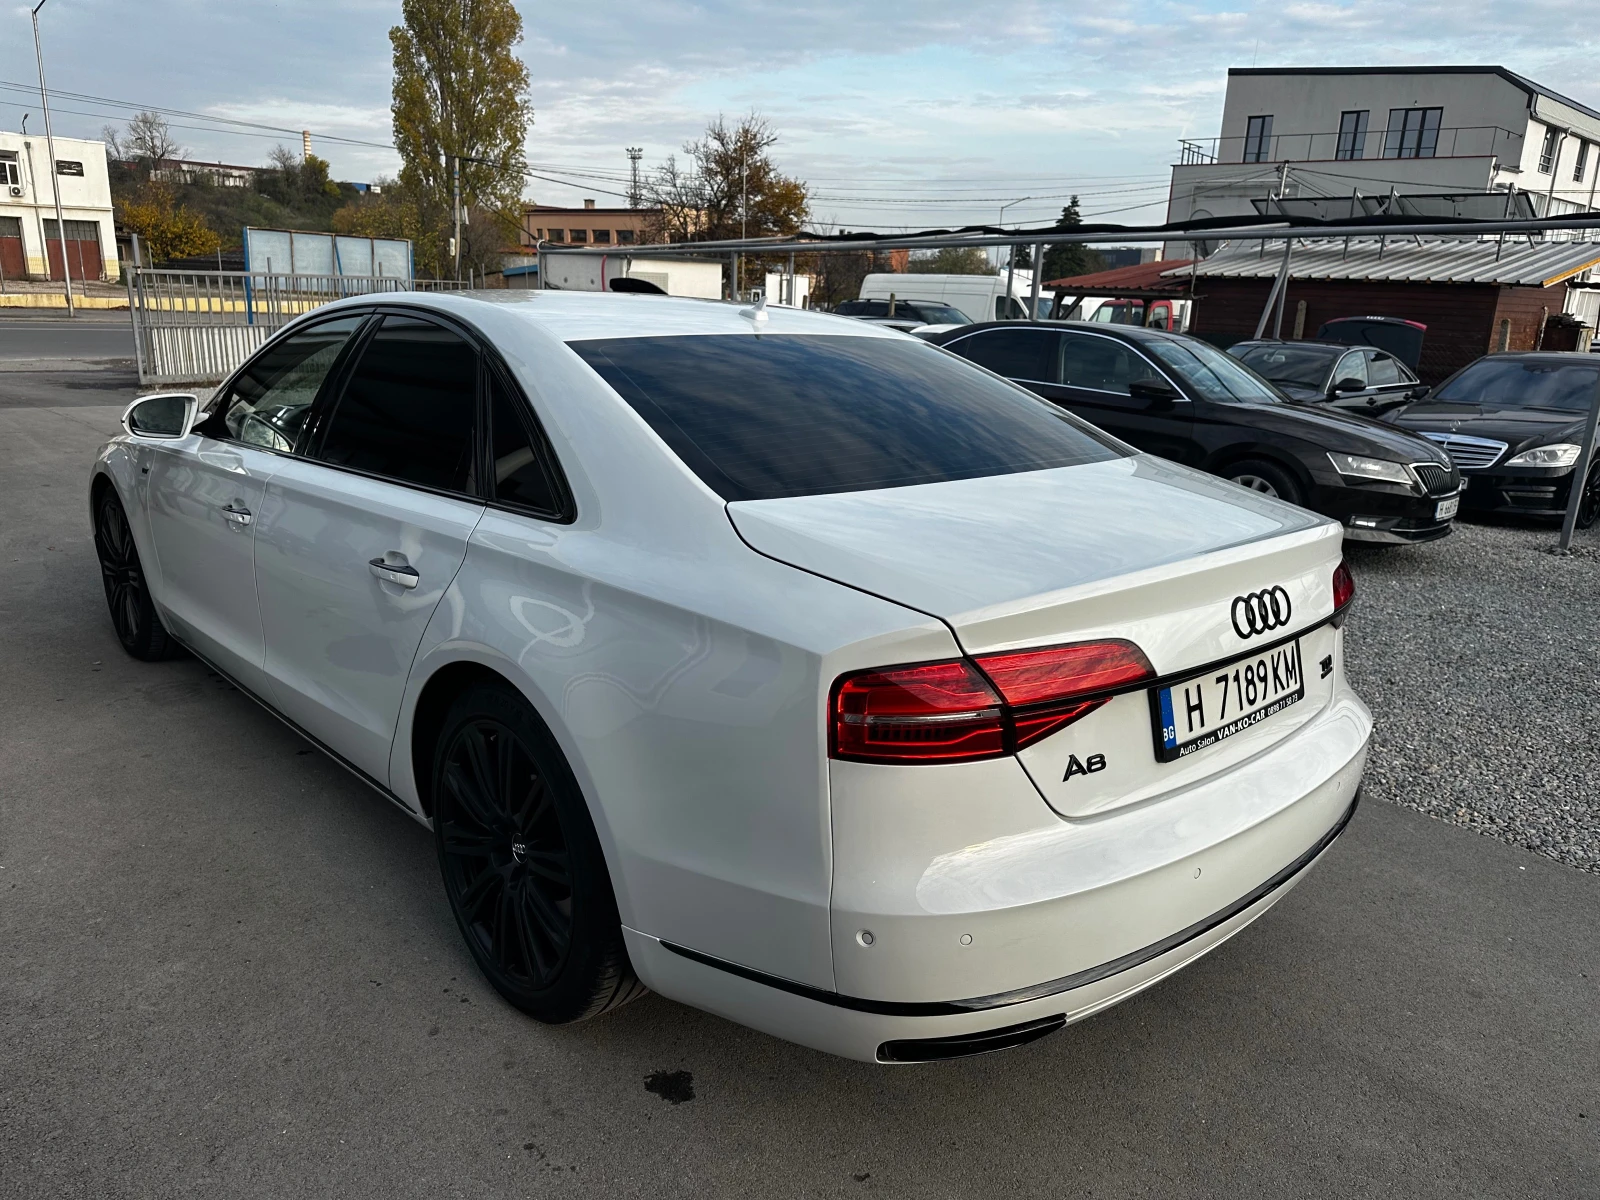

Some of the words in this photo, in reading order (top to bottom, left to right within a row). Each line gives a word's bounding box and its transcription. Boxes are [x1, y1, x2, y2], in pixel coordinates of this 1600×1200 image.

[1185, 684, 1205, 733] H
[1216, 659, 1267, 720] 7189
[1271, 645, 1298, 694] KM
[1163, 725, 1174, 741] BG
[1180, 743, 1197, 757] Auto
[1197, 736, 1215, 749] Salon
[1217, 709, 1265, 740] VAN-KO-CAR
[1062, 753, 1107, 782] A8
